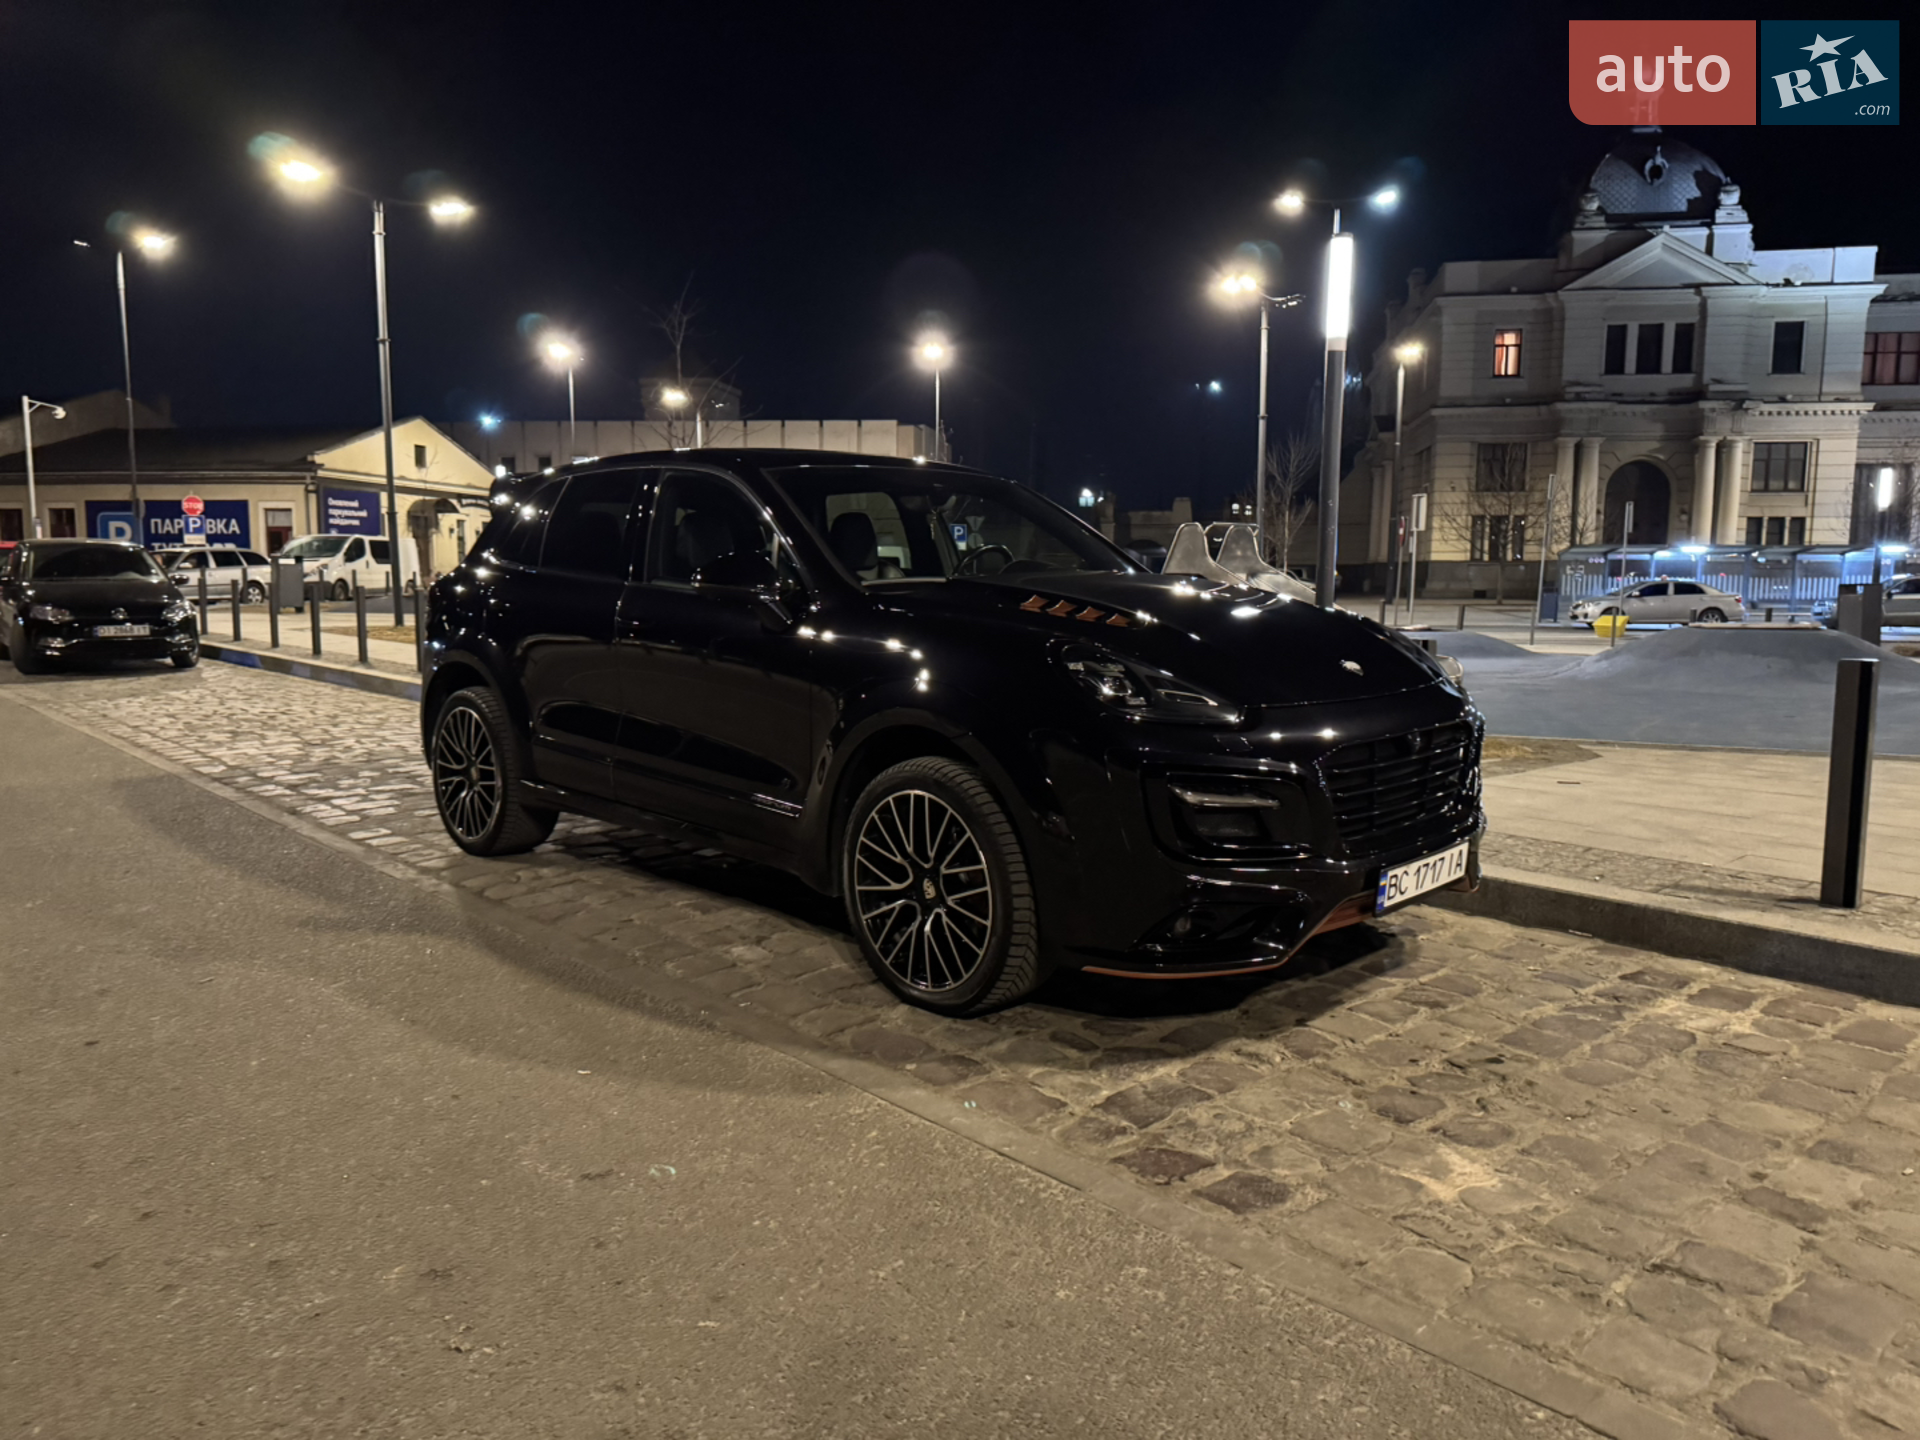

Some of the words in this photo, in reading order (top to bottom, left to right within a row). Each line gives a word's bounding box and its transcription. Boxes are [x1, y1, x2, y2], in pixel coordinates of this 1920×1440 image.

[150, 518, 241, 534] ПАРВКА
[189, 517, 201, 533] P
[1387, 870, 1409, 901] BC
[1414, 857, 1446, 890] 1717
[1448, 849, 1464, 877] IA
